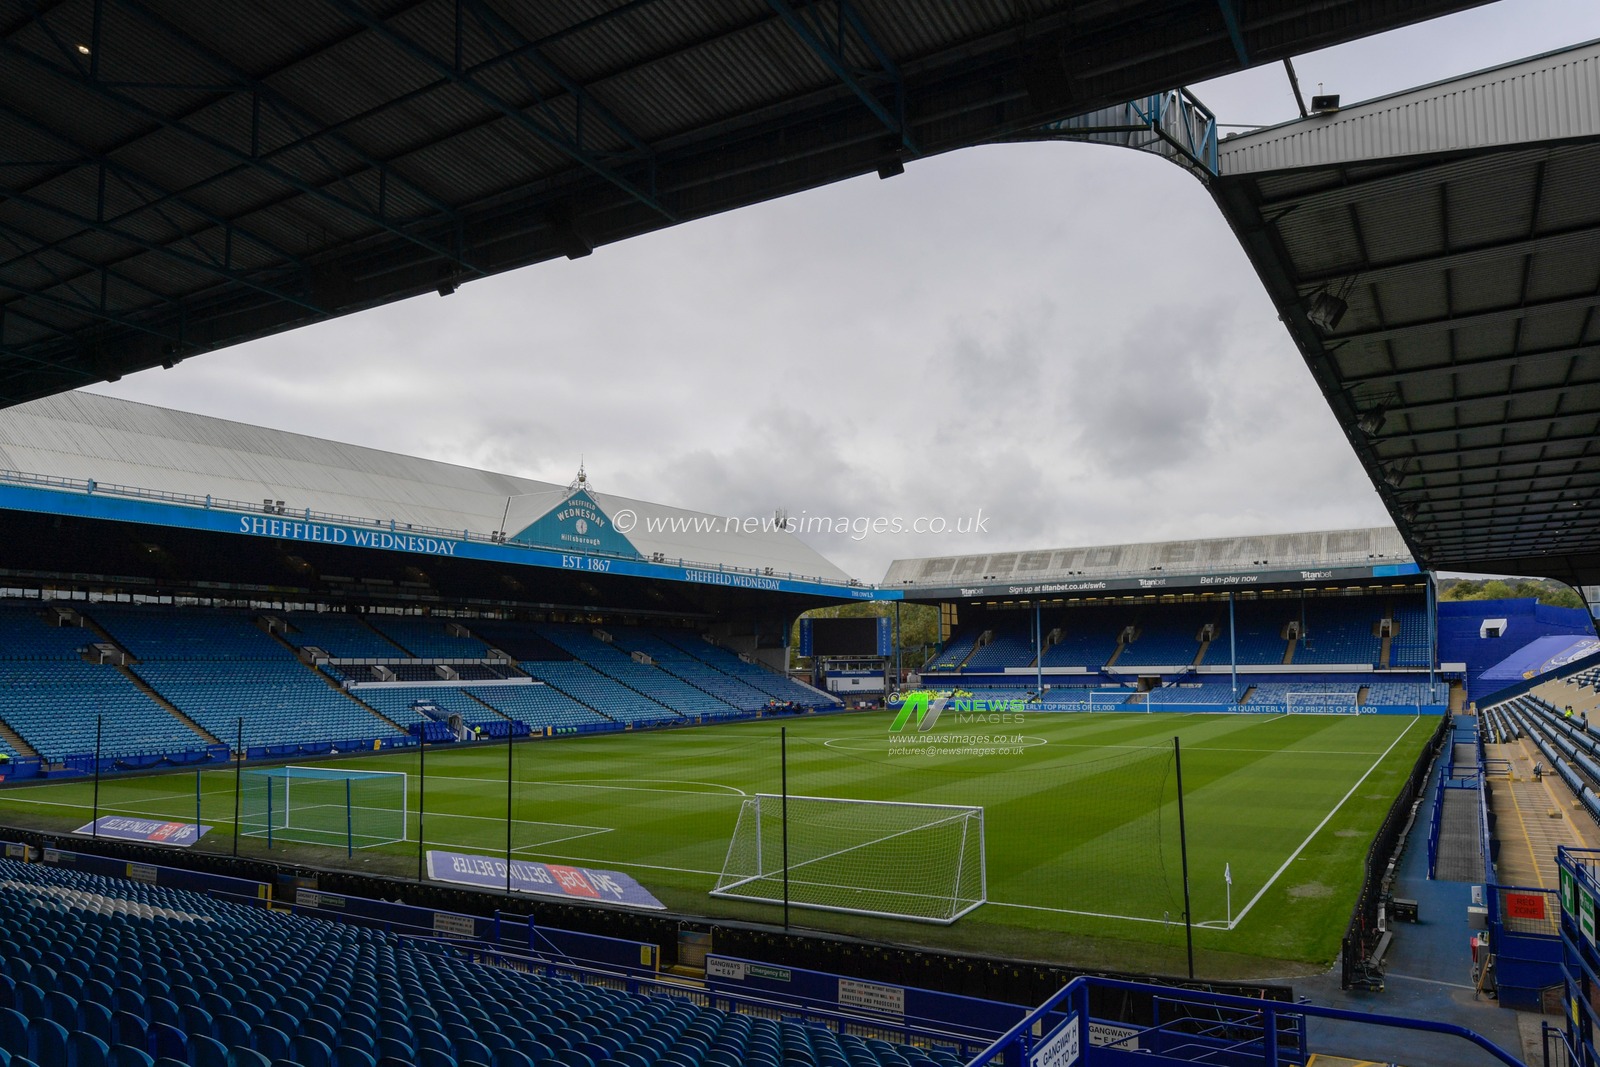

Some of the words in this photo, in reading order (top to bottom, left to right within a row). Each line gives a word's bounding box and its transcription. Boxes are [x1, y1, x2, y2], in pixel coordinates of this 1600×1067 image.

[568, 499, 596, 511] SHEFFIELD
[556, 508, 606, 529] WEDNESDAY
[239, 515, 348, 545] SHEFFIELD
[353, 530, 458, 556] WEDNESDAY
[561, 533, 601, 546] Hillsborough
[562, 554, 584, 570] EST.
[587, 557, 611, 573] 1867
[685, 569, 732, 586] SHEFFIELD
[732, 574, 781, 591] WEDNESDAY
[1138, 577, 1166, 588] Titanbet
[1200, 576, 1214, 585] Bet
[1214, 575, 1240, 586] in-play
[1241, 574, 1258, 583] now
[859, 590, 874, 599] OWLS
[960, 587, 984, 597] Titanbet
[1008, 585, 1021, 595] Sign
[1021, 586, 1033, 595] up
[1034, 585, 1042, 593] at
[1042, 582, 1106, 592] titanbet.co.uk/swfc
[1043, 703, 1057, 711] TOP
[1057, 703, 1081, 711] PRIZES
[1081, 703, 1091, 711] OF
[1093, 703, 1116, 712] £5,000
[1237, 705, 1286, 714] QUARTERLY
[1287, 706, 1304, 714] TOP
[452, 856, 496, 878] BETTER
[495, 862, 554, 884] BETTING
[552, 868, 594, 894] bet
[583, 869, 624, 900] sky
[1516, 898, 1535, 906] RED
[1515, 906, 1539, 915] ZONE
[710, 959, 741, 971] GANGWAYS
[751, 966, 779, 979] Emergency
[779, 970, 790, 979] Exit
[1088, 1025, 1133, 1038] GANGWAYS
[1043, 1029, 1072, 1066] GANGWAY
[1072, 1024, 1077, 1039] H
[1062, 1049, 1070, 1066] TO
[1071, 1041, 1077, 1056] 42
